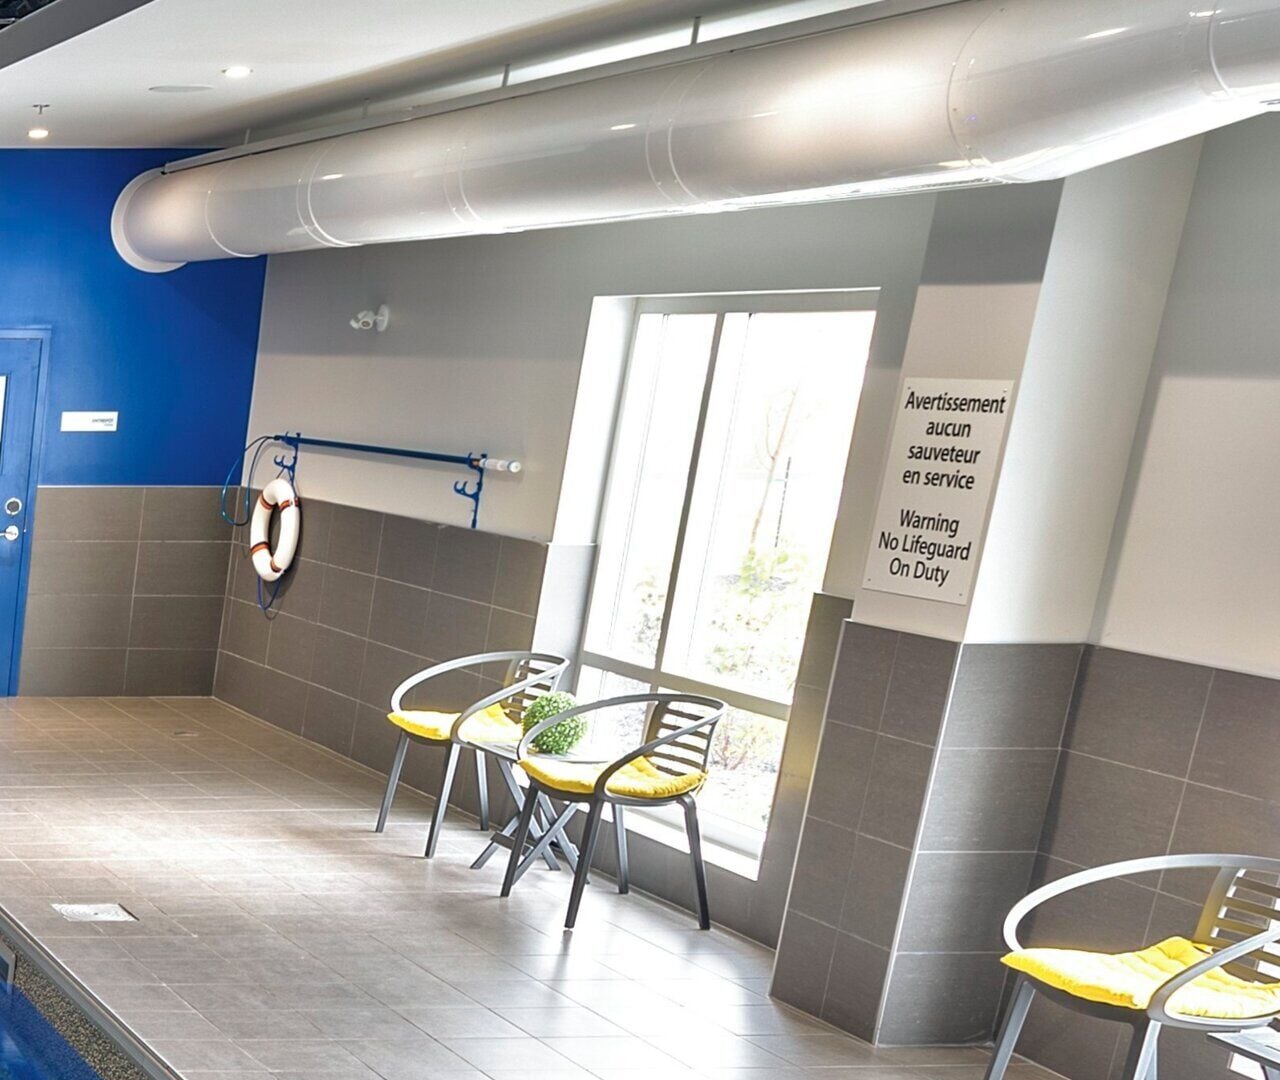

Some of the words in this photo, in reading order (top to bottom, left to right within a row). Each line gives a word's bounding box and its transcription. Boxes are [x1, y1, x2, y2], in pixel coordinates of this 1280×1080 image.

[904, 391, 1007, 414] Avertissement
[925, 421, 971, 438] aucun
[907, 445, 981, 464] sauveteur
[902, 469, 920, 485] en
[923, 470, 975, 490] service
[900, 508, 960, 538] Warning
[878, 531, 899, 551] No
[902, 534, 972, 561] Lifeguard
[889, 558, 910, 577] On
[913, 560, 950, 587] Duty
